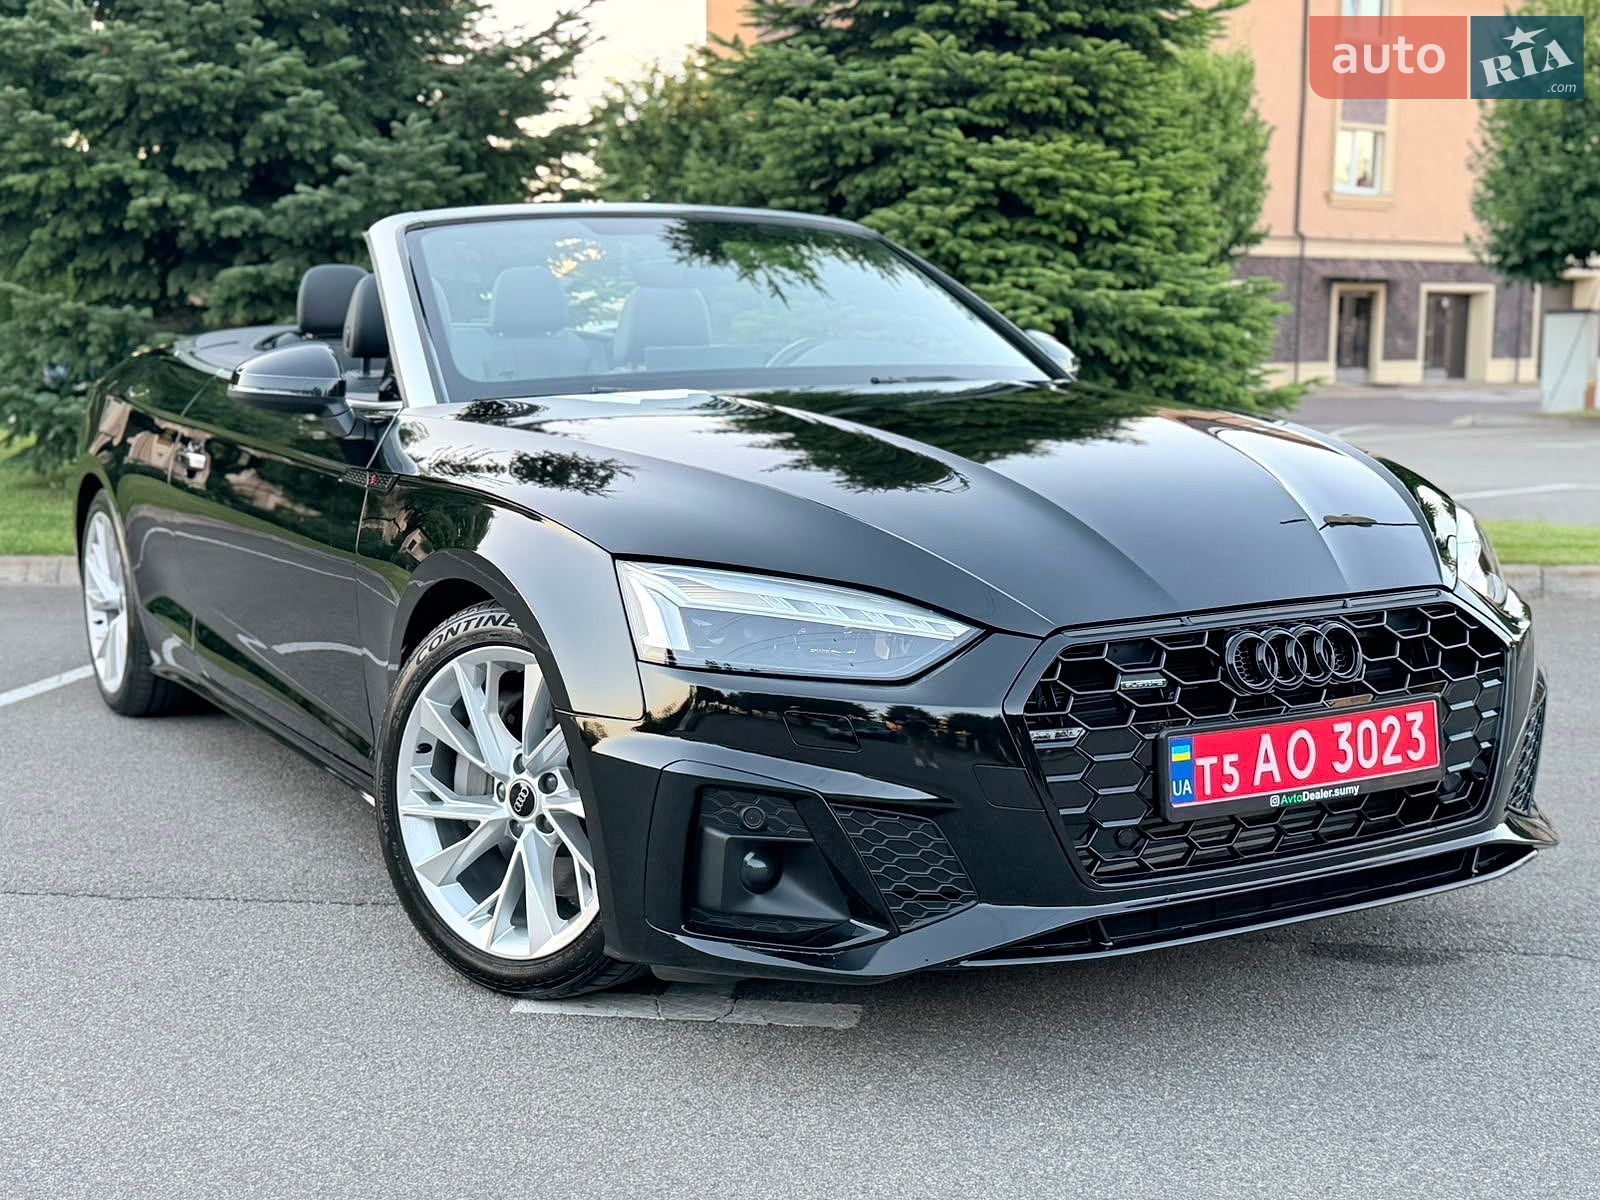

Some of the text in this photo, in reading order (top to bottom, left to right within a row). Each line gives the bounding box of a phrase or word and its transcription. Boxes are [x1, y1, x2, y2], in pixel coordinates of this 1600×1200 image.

[1195, 711, 1426, 795] T5 AO 3023
[1172, 778, 1193, 797] UA
